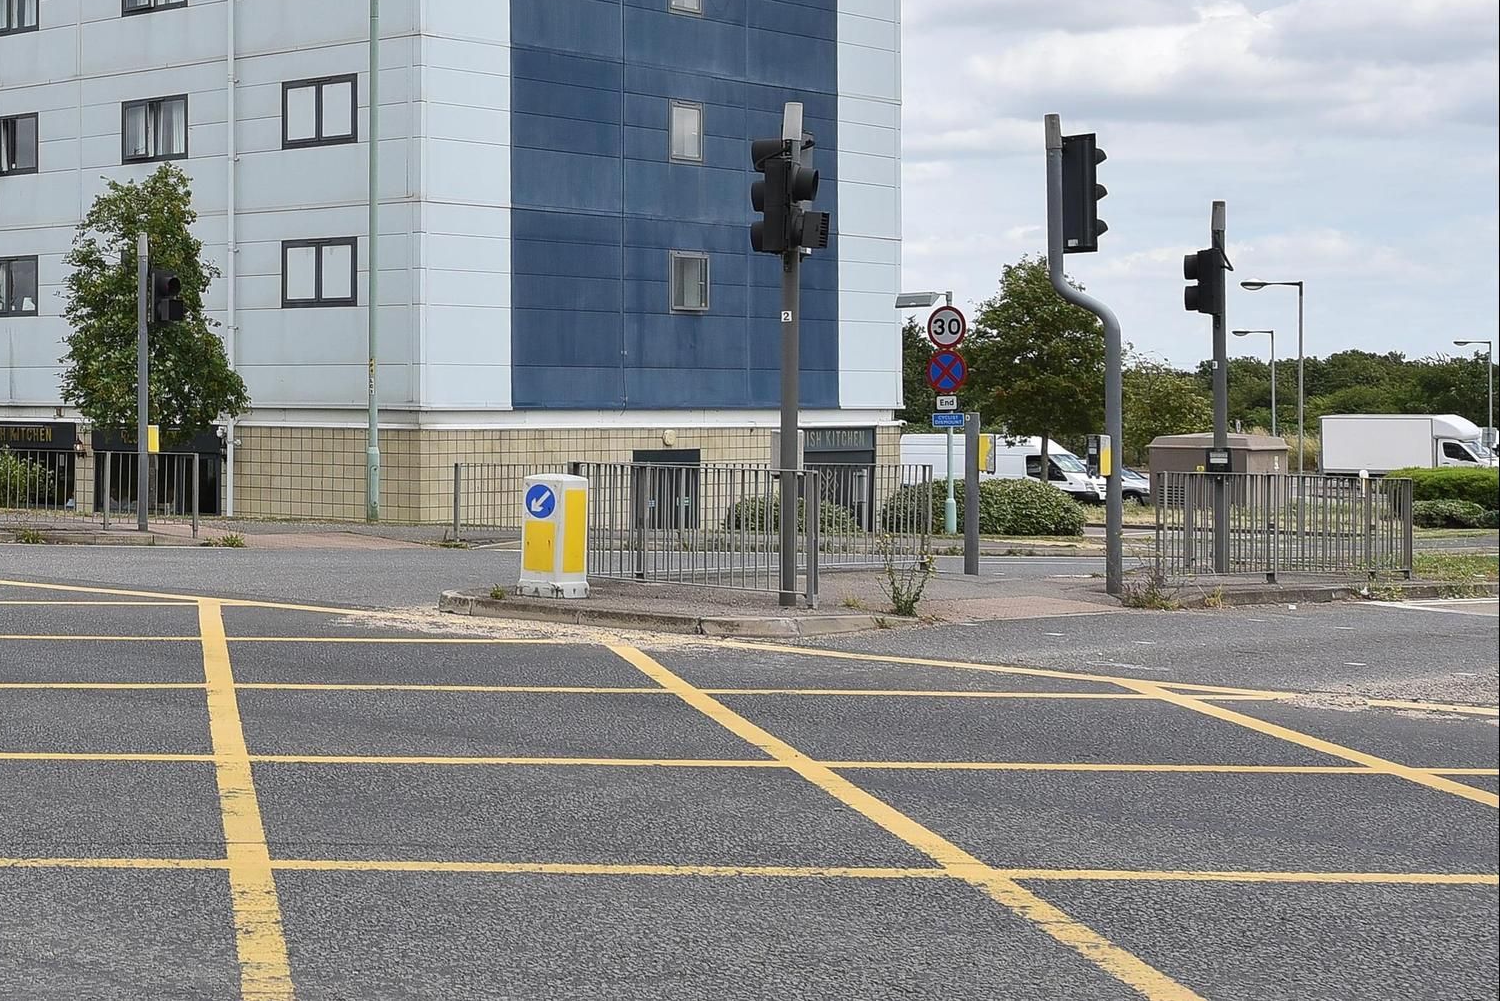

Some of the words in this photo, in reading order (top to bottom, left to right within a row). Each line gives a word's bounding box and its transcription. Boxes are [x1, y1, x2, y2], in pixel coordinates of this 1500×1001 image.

[783, 311, 790, 321] 2
[932, 318, 961, 336] 30
[939, 398, 955, 407] End
[10, 426, 52, 442] KITCHEN
[825, 430, 866, 448] KITCHEN
